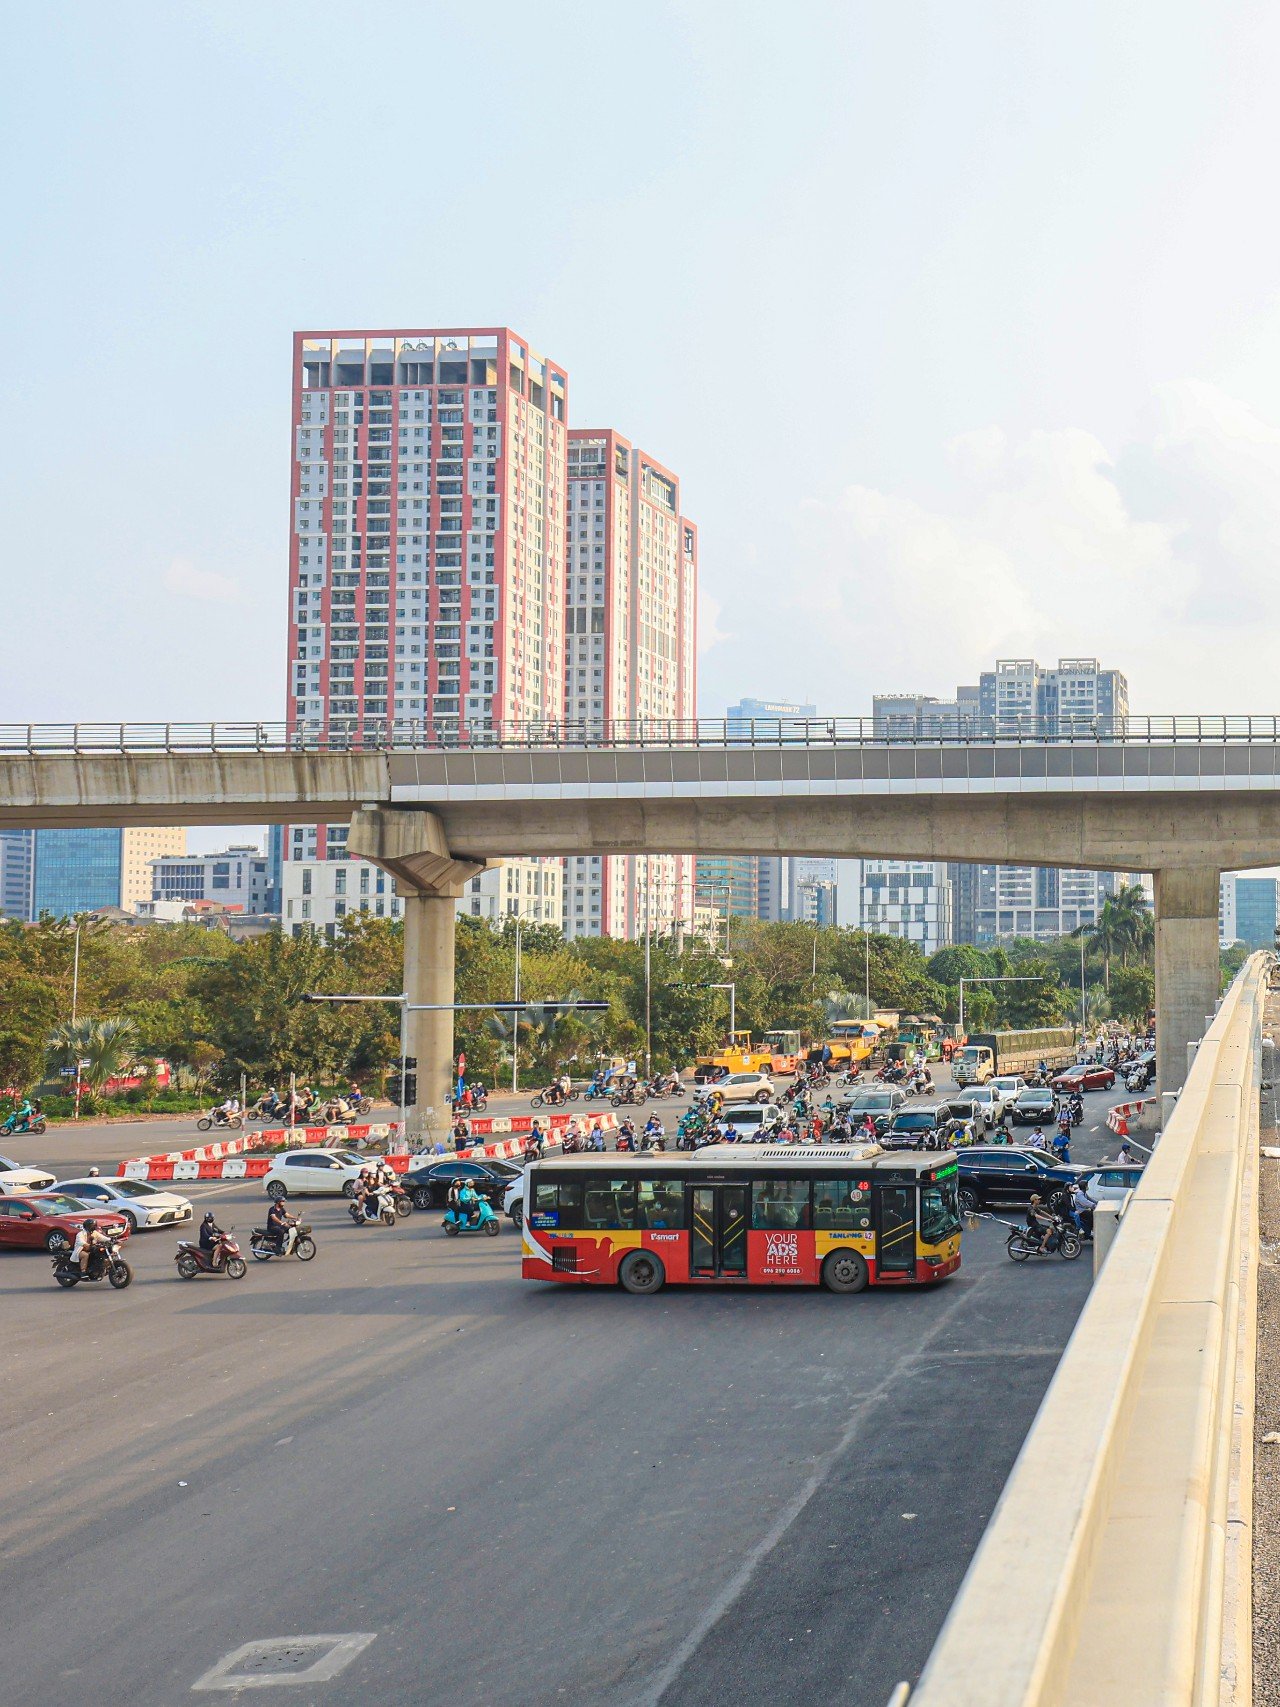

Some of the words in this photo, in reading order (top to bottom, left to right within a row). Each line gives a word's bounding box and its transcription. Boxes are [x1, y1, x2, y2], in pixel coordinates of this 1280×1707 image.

[765, 1233, 798, 1249] YOUR
[767, 1243, 798, 1256] ADS
[766, 1255, 798, 1265] HERE
